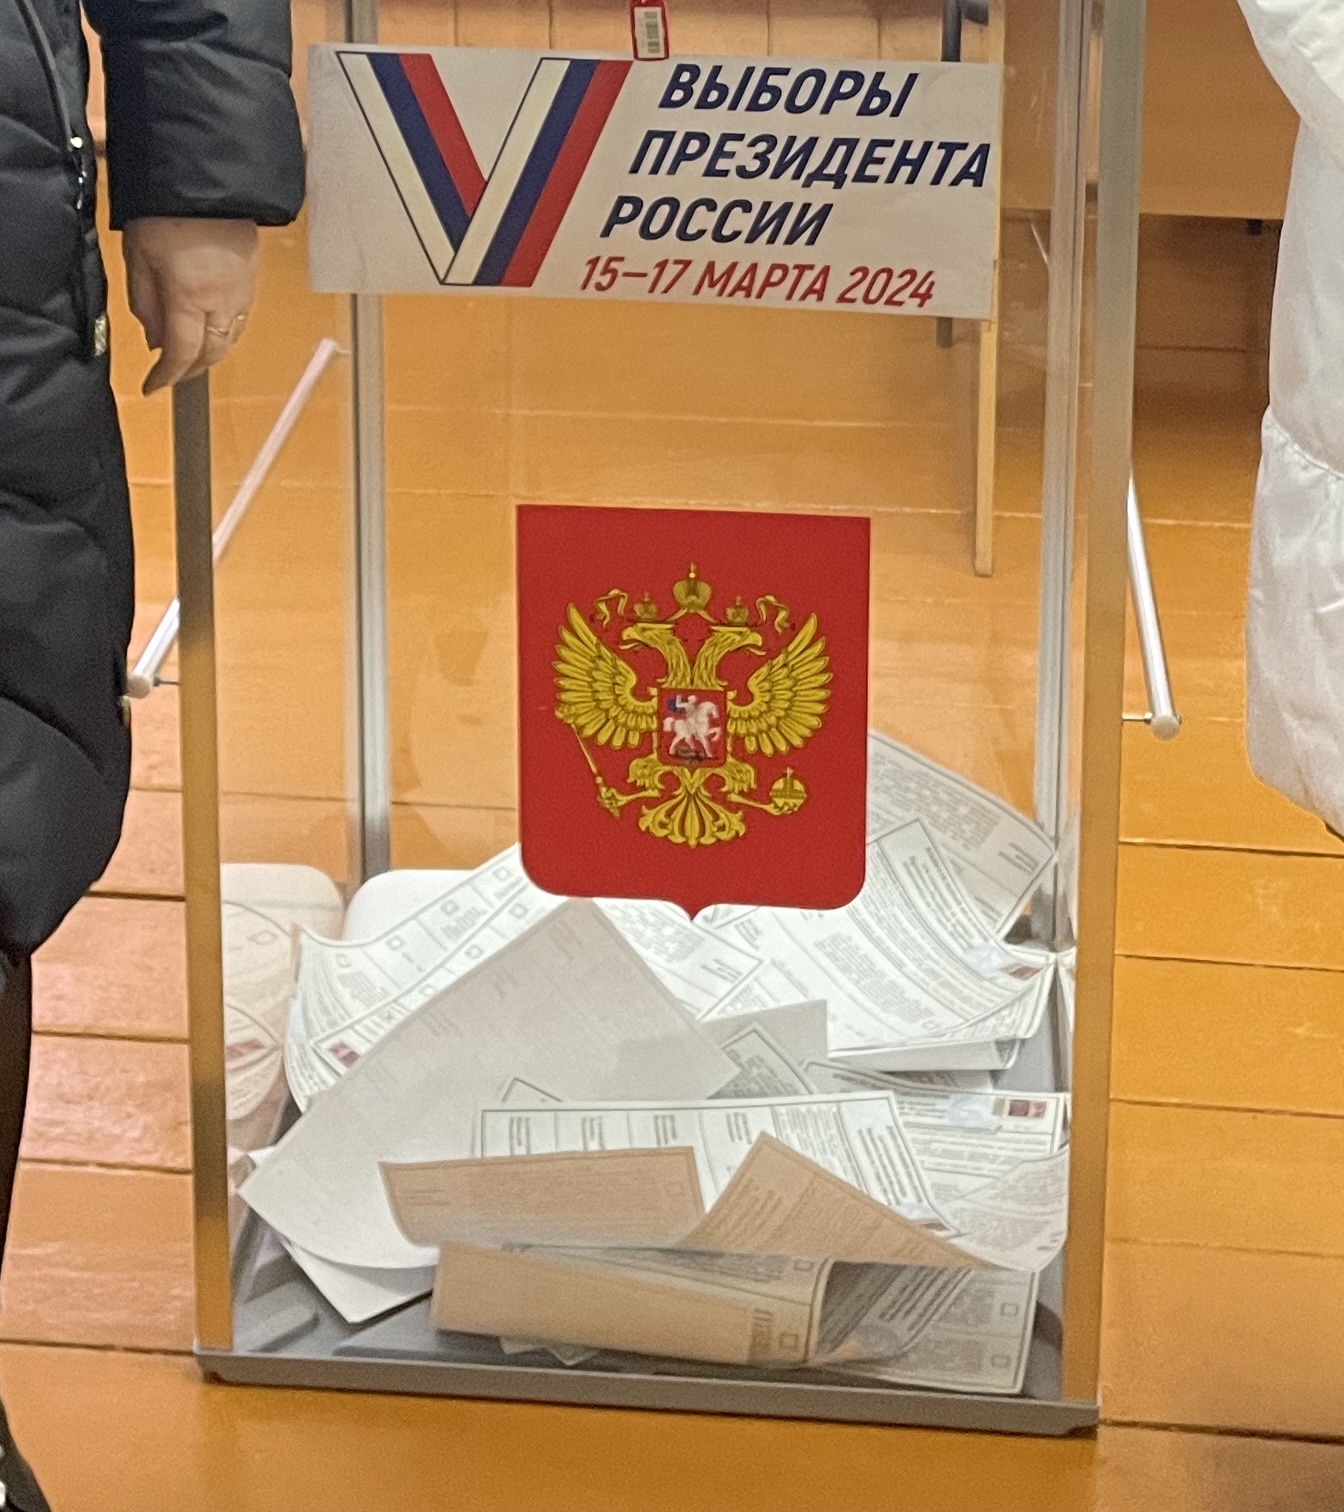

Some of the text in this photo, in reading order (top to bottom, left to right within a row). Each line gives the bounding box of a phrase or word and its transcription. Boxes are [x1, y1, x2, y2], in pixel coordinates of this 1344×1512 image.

[657, 63, 919, 119] ВЫБОРЫ
[628, 129, 992, 190] ПРЕЗИДЕНТА
[600, 195, 834, 247] РОССИИ
[696, 263, 830, 302] МАРТА
[835, 266, 936, 309] 2024
